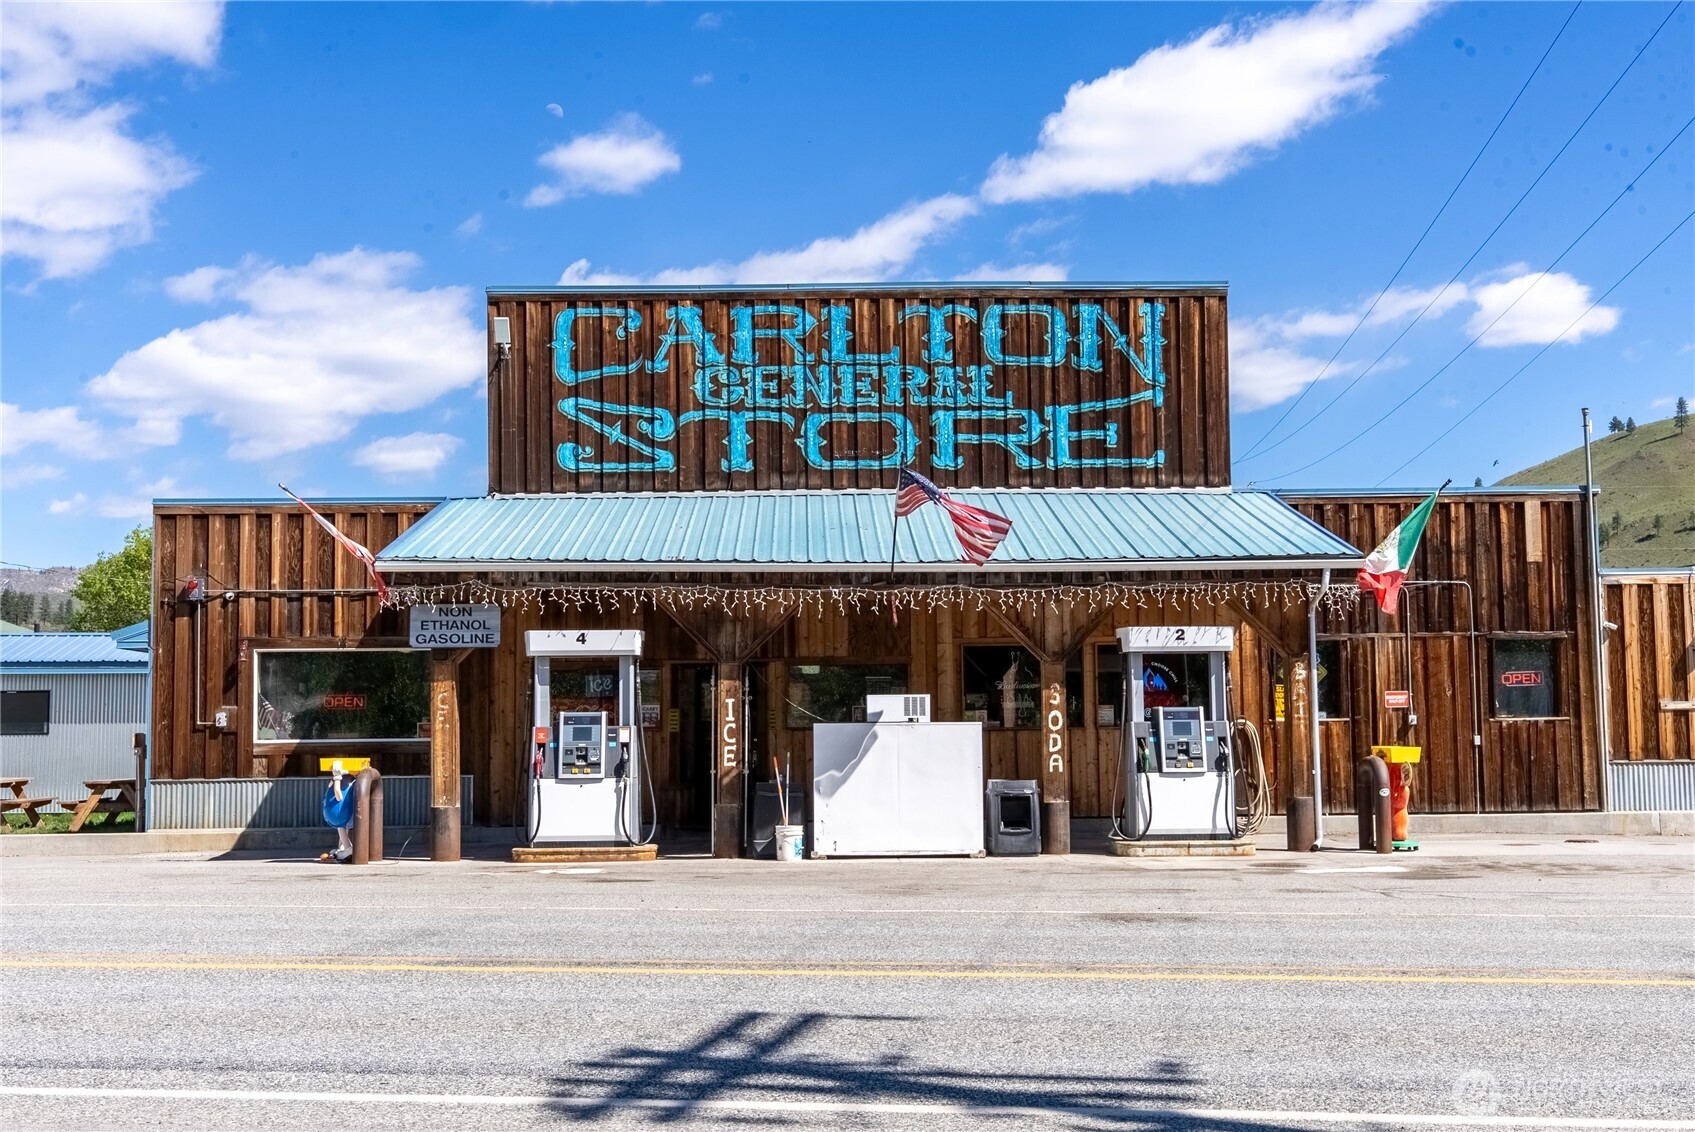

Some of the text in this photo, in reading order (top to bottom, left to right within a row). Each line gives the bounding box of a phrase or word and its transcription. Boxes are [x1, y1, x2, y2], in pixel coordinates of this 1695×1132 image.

[548, 303, 1168, 386] CARLTON
[694, 364, 1014, 408] GENERAL
[556, 389, 1167, 472] STORE
[438, 605, 473, 618] NON
[420, 619, 491, 631] ETHANOL
[415, 632, 495, 645] GASOLINE
[575, 632, 587, 645] 4
[1175, 628, 1185, 641] 2
[1501, 673, 1541, 684] OPEN
[324, 696, 365, 709] OPEN
[723, 698, 737, 767] ICE
[1047, 682, 1064, 773] SODA
